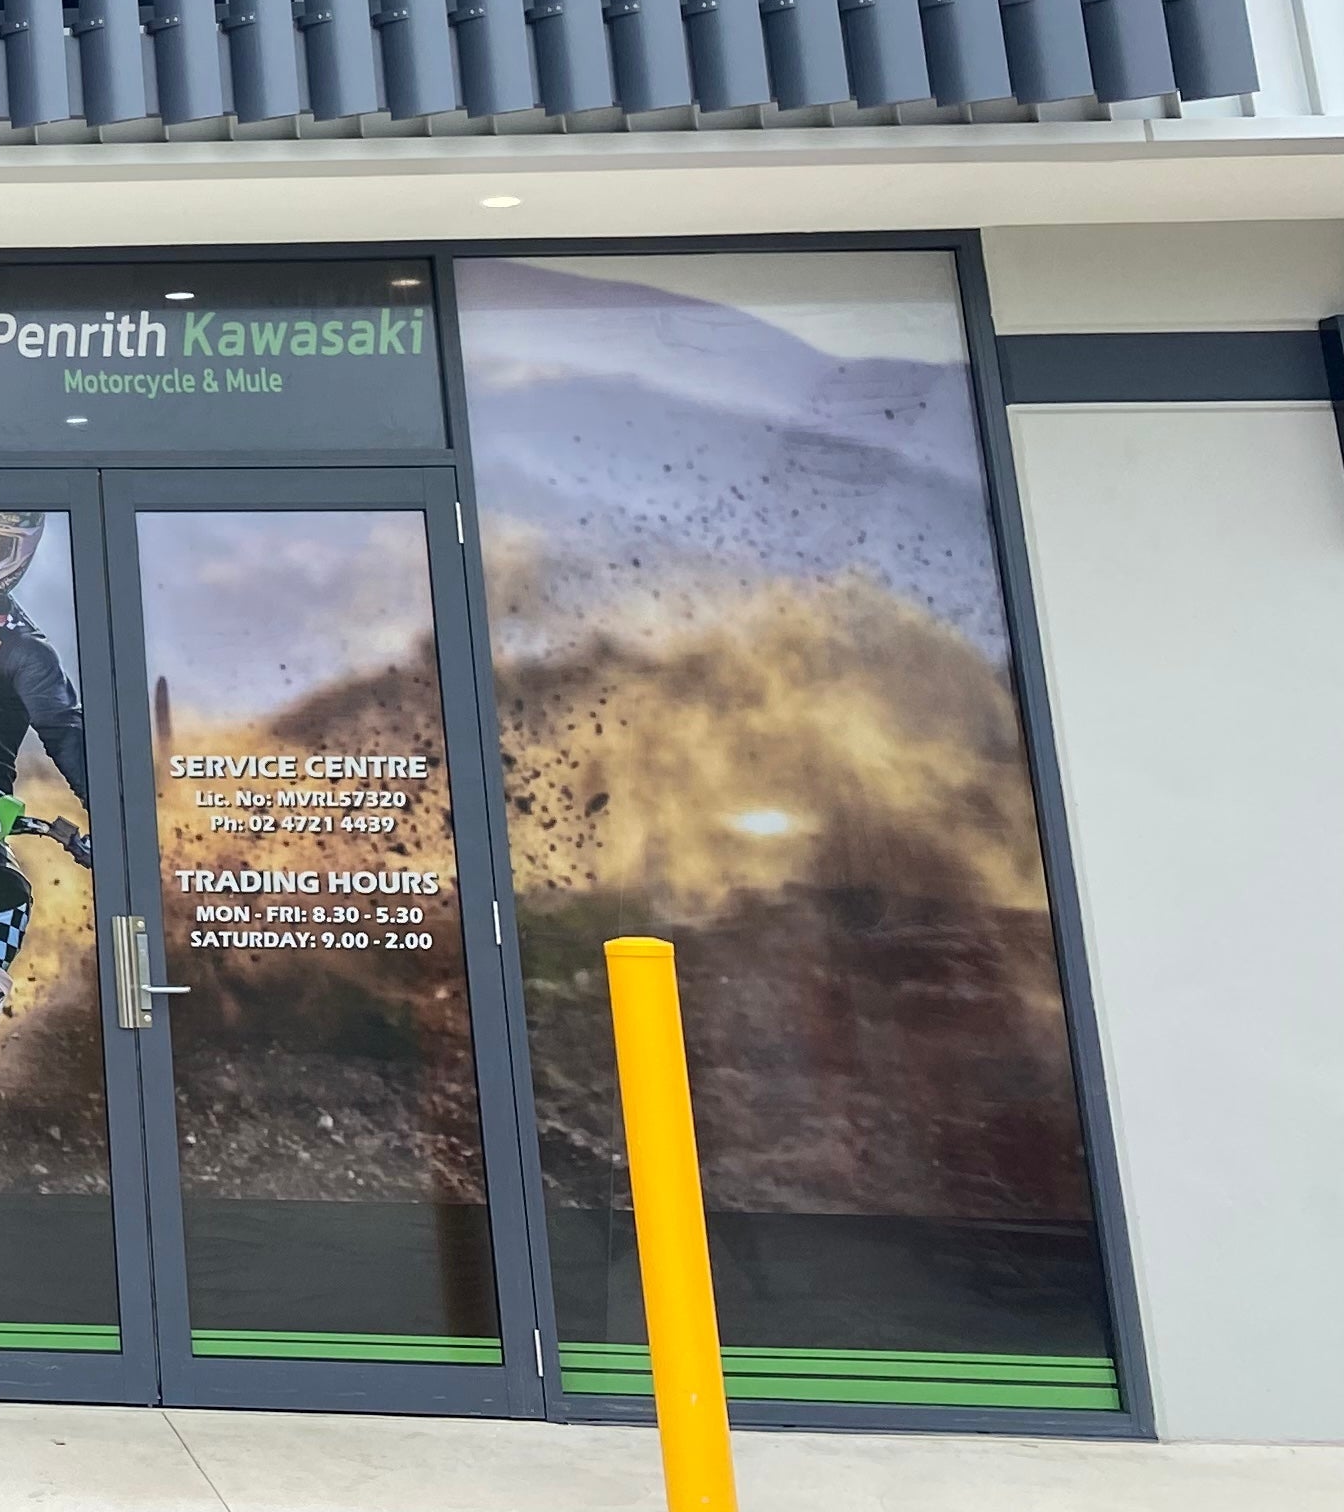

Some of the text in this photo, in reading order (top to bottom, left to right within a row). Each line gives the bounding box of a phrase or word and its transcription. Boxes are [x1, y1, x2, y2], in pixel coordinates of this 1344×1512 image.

[183, 309, 424, 356] Kawasaki
[65, 368, 282, 399] Motorcycle & Mule
[170, 755, 428, 778] SERVICE CENTRE
[195, 791, 407, 808] Lic. No: MVRL57320
[210, 816, 395, 833] Ph: 02 4721 4439
[175, 870, 439, 895] TRADING HOURS
[196, 906, 250, 922] MON
[266, 906, 307, 922] FRI:
[312, 906, 360, 923] 8.30
[376, 907, 423, 924] 5.30
[190, 931, 316, 948] SATURDAY:
[321, 932, 369, 949] 9.00
[384, 932, 433, 949] 2.00
